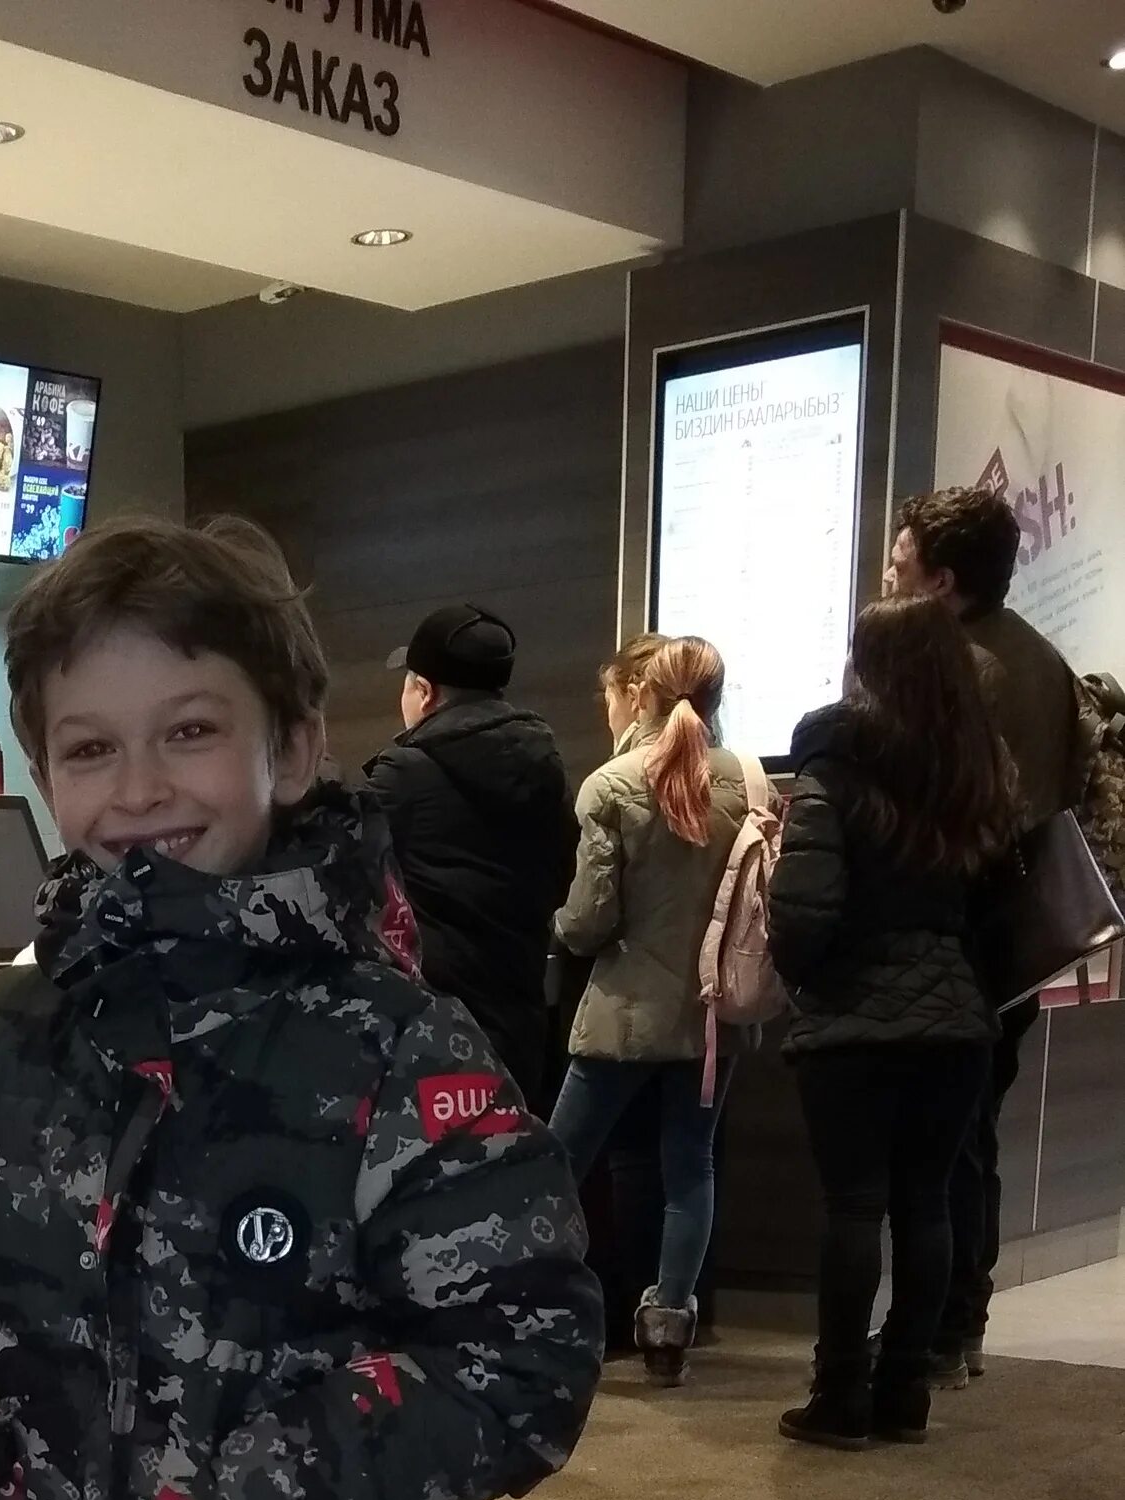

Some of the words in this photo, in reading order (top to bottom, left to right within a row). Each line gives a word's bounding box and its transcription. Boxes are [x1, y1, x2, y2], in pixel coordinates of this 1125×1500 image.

[242, 27, 400, 136] ЗАКАЗ
[34, 380, 66, 398] АРАБИКА
[676, 389, 719, 415] НАШИ
[722, 380, 765, 409] ЦЕНЫ
[32, 394, 66, 415] КОФЕ
[37, 415, 46, 426] 69
[675, 411, 734, 441] БИЗДИН
[26, 503, 35, 514] 39
